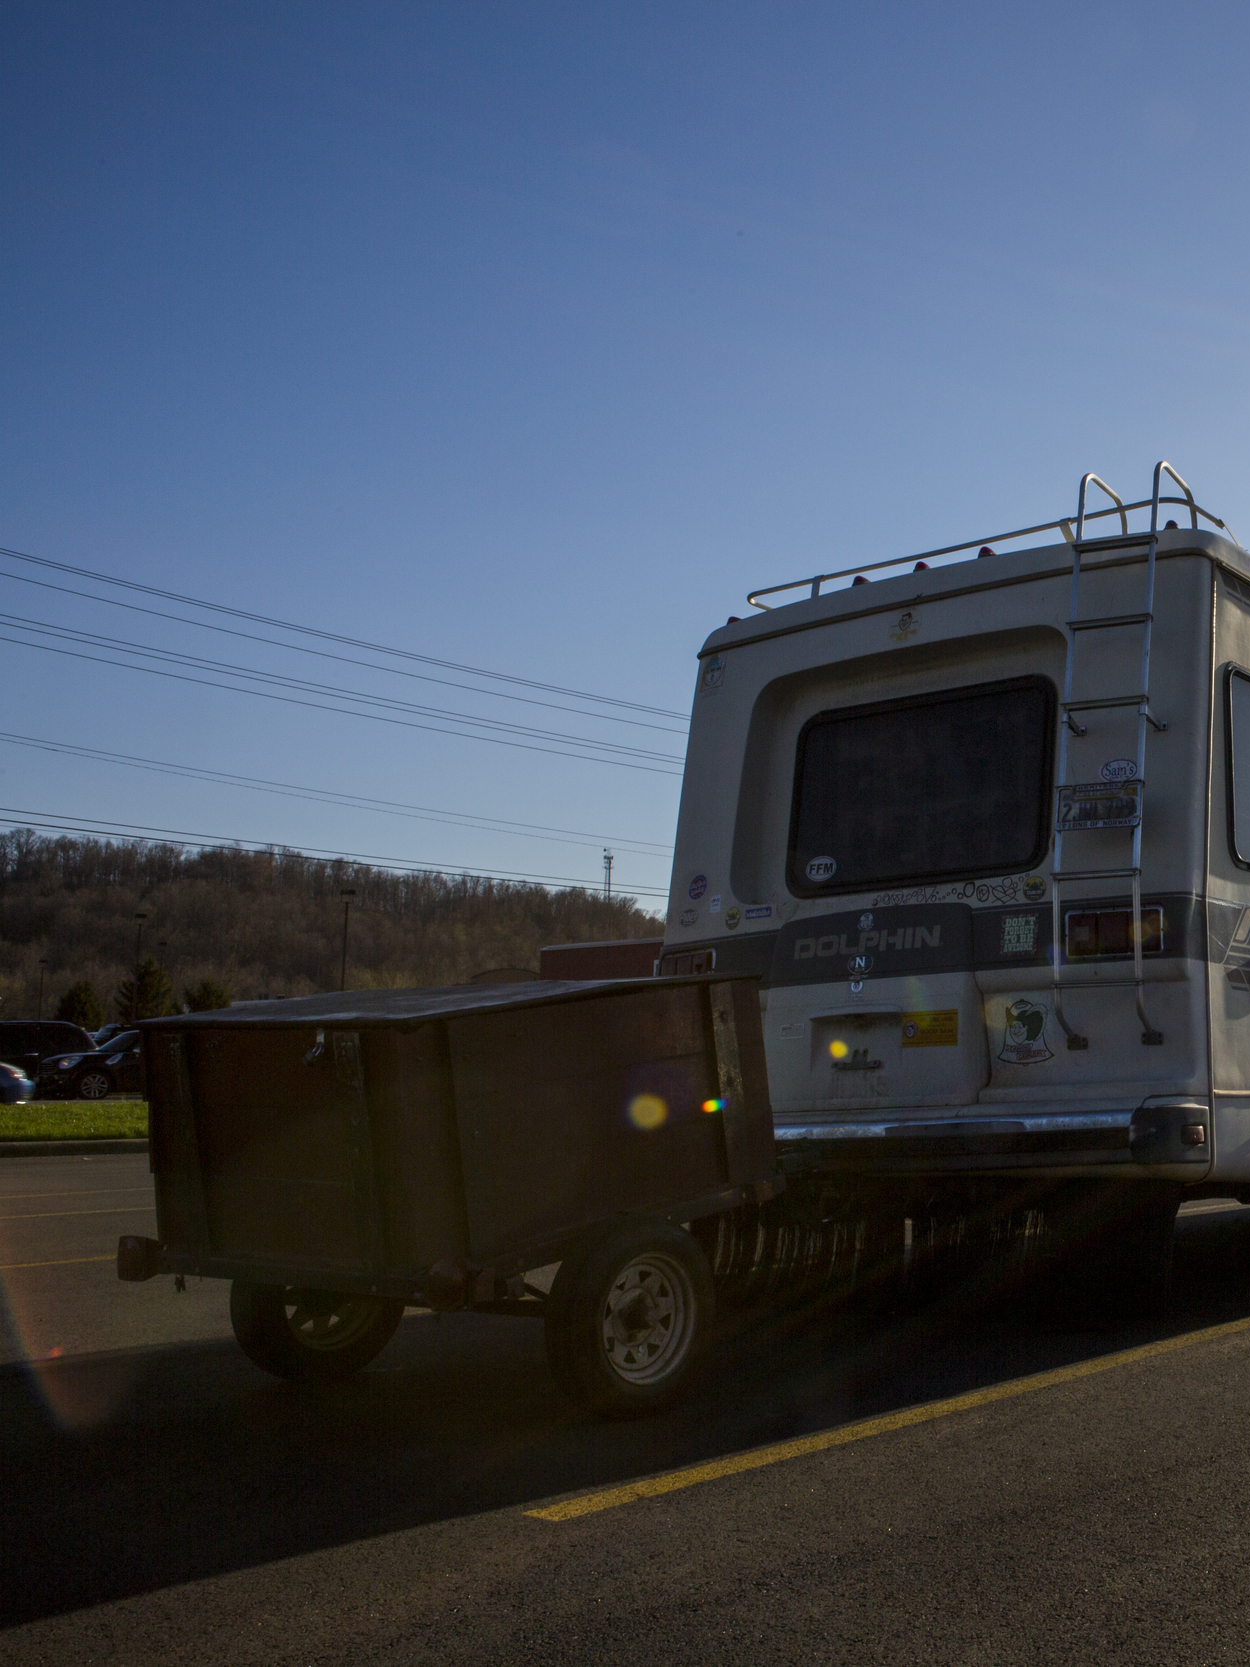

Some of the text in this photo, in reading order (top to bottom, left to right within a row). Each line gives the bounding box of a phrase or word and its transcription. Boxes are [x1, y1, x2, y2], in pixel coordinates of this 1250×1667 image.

[1104, 763, 1134, 777] Sam's
[1103, 818, 1132, 826] NORWAY
[809, 862, 834, 875] FFM
[1005, 916, 1036, 927] DON'T
[1004, 925, 1035, 936] FORGET
[794, 925, 941, 961] DOLPHIN
[1004, 933, 1034, 944] TO BE
[1003, 942, 1033, 953] AWESOME
[855, 956, 866, 968] N
